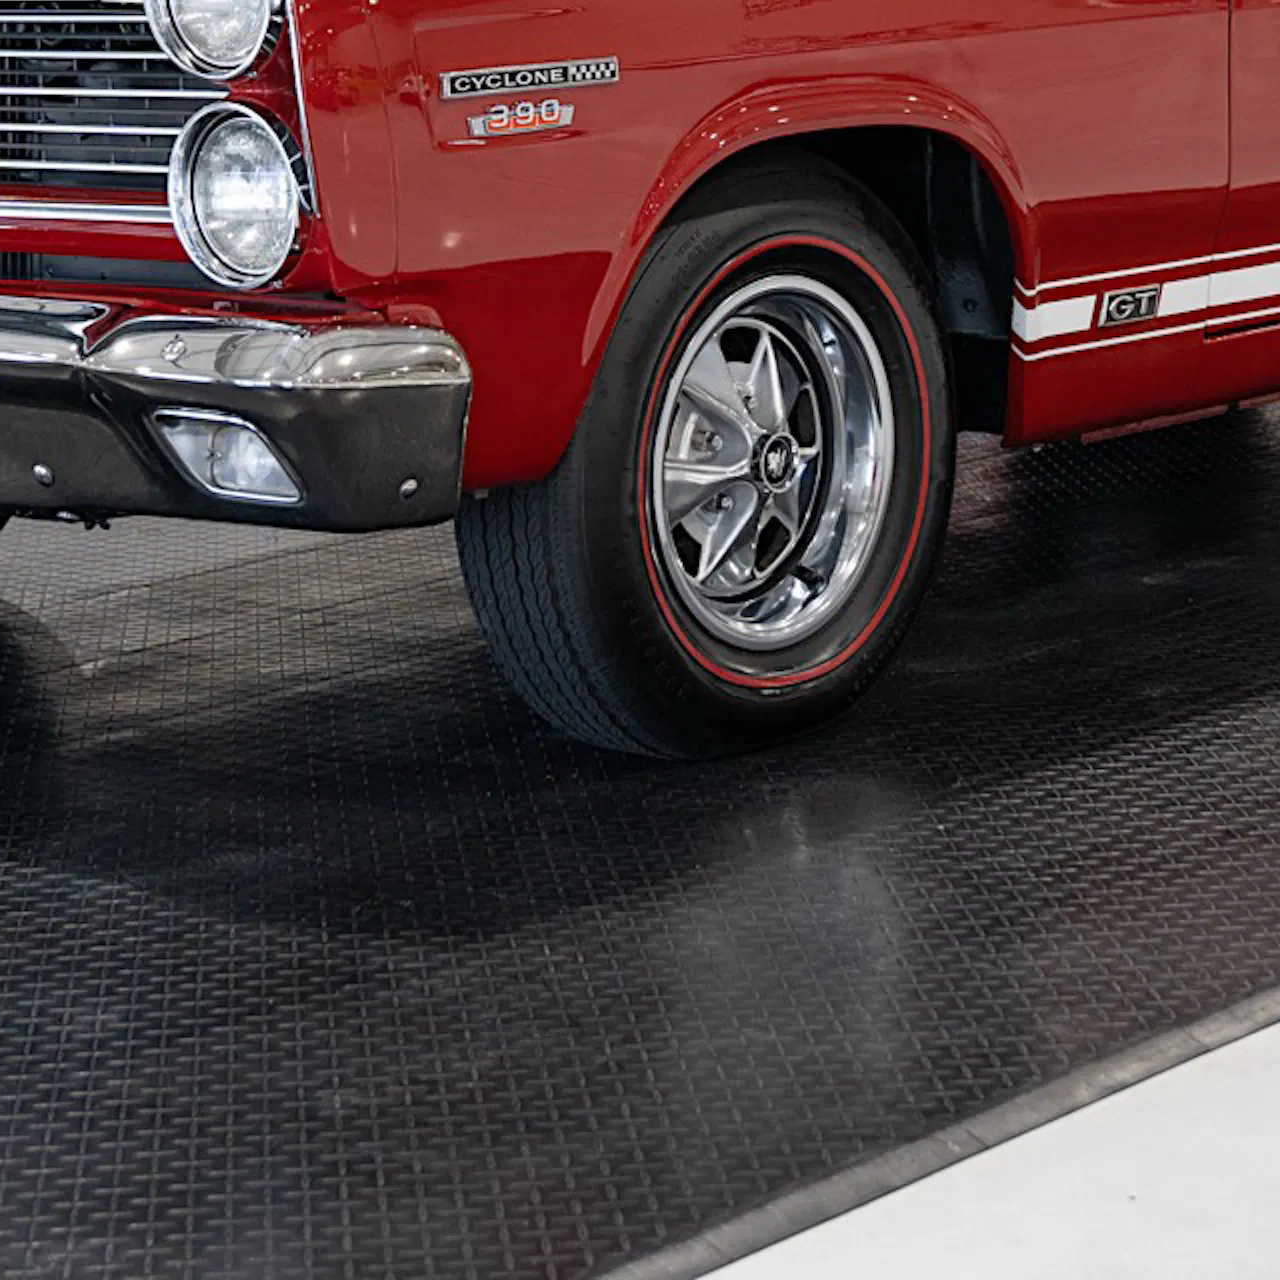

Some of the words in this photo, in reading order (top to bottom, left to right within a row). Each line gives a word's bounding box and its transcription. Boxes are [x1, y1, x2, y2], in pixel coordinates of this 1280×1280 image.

[454, 68, 565, 92] CYCLONE
[488, 98, 560, 129] 390
[1109, 291, 1157, 321] GT
